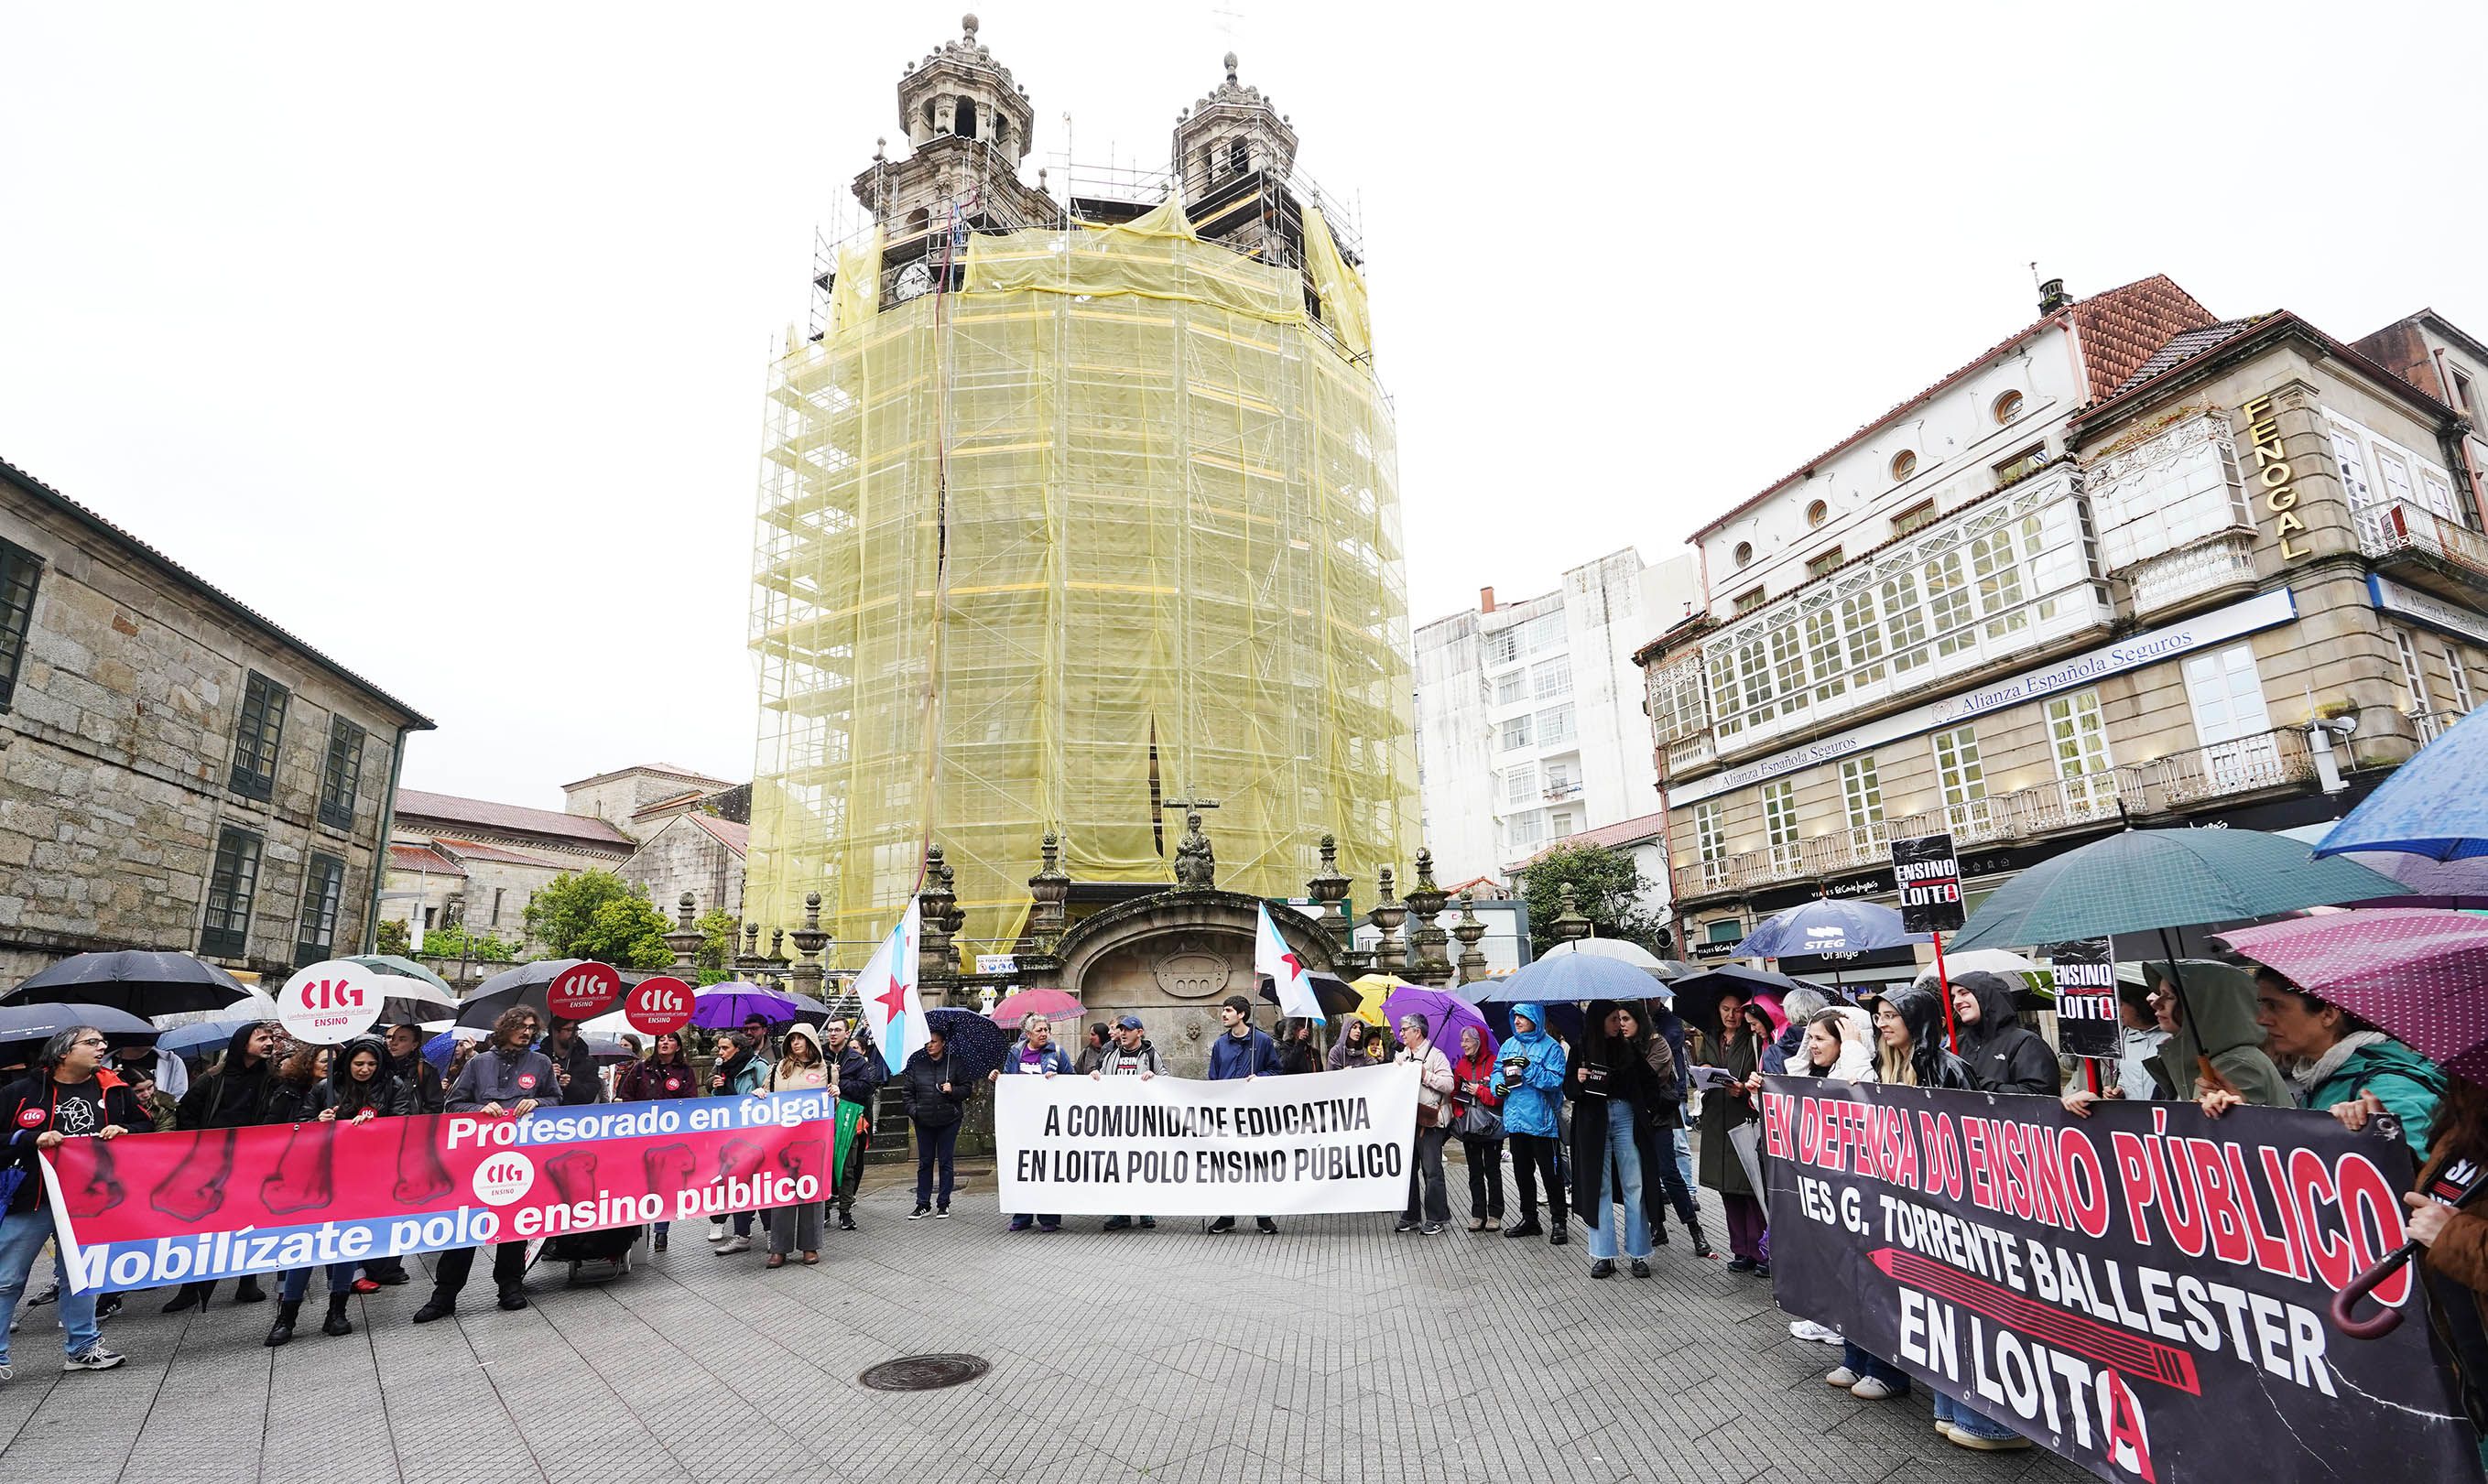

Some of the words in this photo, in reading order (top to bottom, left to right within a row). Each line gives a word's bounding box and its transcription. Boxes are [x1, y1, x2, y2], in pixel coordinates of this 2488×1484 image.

[2244, 395, 2313, 560] FENOGAL
[1961, 685, 2022, 713] Alianza
[2025, 658, 2107, 693] Española
[2111, 632, 2193, 665] Seguros
[1722, 768, 1759, 788] Alianza
[1759, 753, 1809, 775] Española
[1809, 737, 1857, 759] Seguros
[1896, 859, 1956, 881] ENSINO
[1811, 889, 1834, 897] VIAES
[1898, 881, 1909, 890] EN
[1803, 938, 1846, 949] STEG
[1820, 949, 1859, 960] Orange
[564, 974, 608, 996] CIG
[2053, 964, 2113, 986] ENSINO
[300, 979, 364, 1010] CIG
[641, 990, 684, 1012] CIG
[2054, 986, 2065, 996] EN
[314, 1016, 348, 1026] ENSINO
[447, 1105, 687, 1150] Profesorado
[690, 1109, 731, 1131] en
[739, 1092, 831, 1127] folga!
[1044, 1105, 1060, 1136] A
[1067, 1105, 1228, 1137] COMUNIDADE
[1234, 1098, 1371, 1138] EDUCATIVA
[487, 1164, 523, 1183] CIG
[1016, 1150, 1047, 1182] EN
[1054, 1150, 1120, 1183] LOITA
[1126, 1151, 1189, 1184] POLO
[1196, 1150, 1287, 1184] ENSINO
[1294, 1143, 1401, 1181] PÚBLICO
[1762, 1092, 1796, 1161] EN
[1798, 1096, 1919, 1191] DEFENSA
[1918, 1110, 1964, 1202] DO
[1961, 1115, 2110, 1239] ENSINO
[2111, 1107, 2413, 1308] PÚBLICO
[389, 1206, 500, 1257] polo
[514, 1190, 664, 1235] ensino
[676, 1171, 819, 1220] público
[1797, 1175, 1837, 1225] IES
[1841, 1186, 1870, 1237] G.
[1880, 1195, 2026, 1293] TORRENTE
[2026, 1239, 2338, 1398] BALLESTER
[1898, 1285, 1959, 1382] EN
[1971, 1316, 2157, 1484] LOITA
